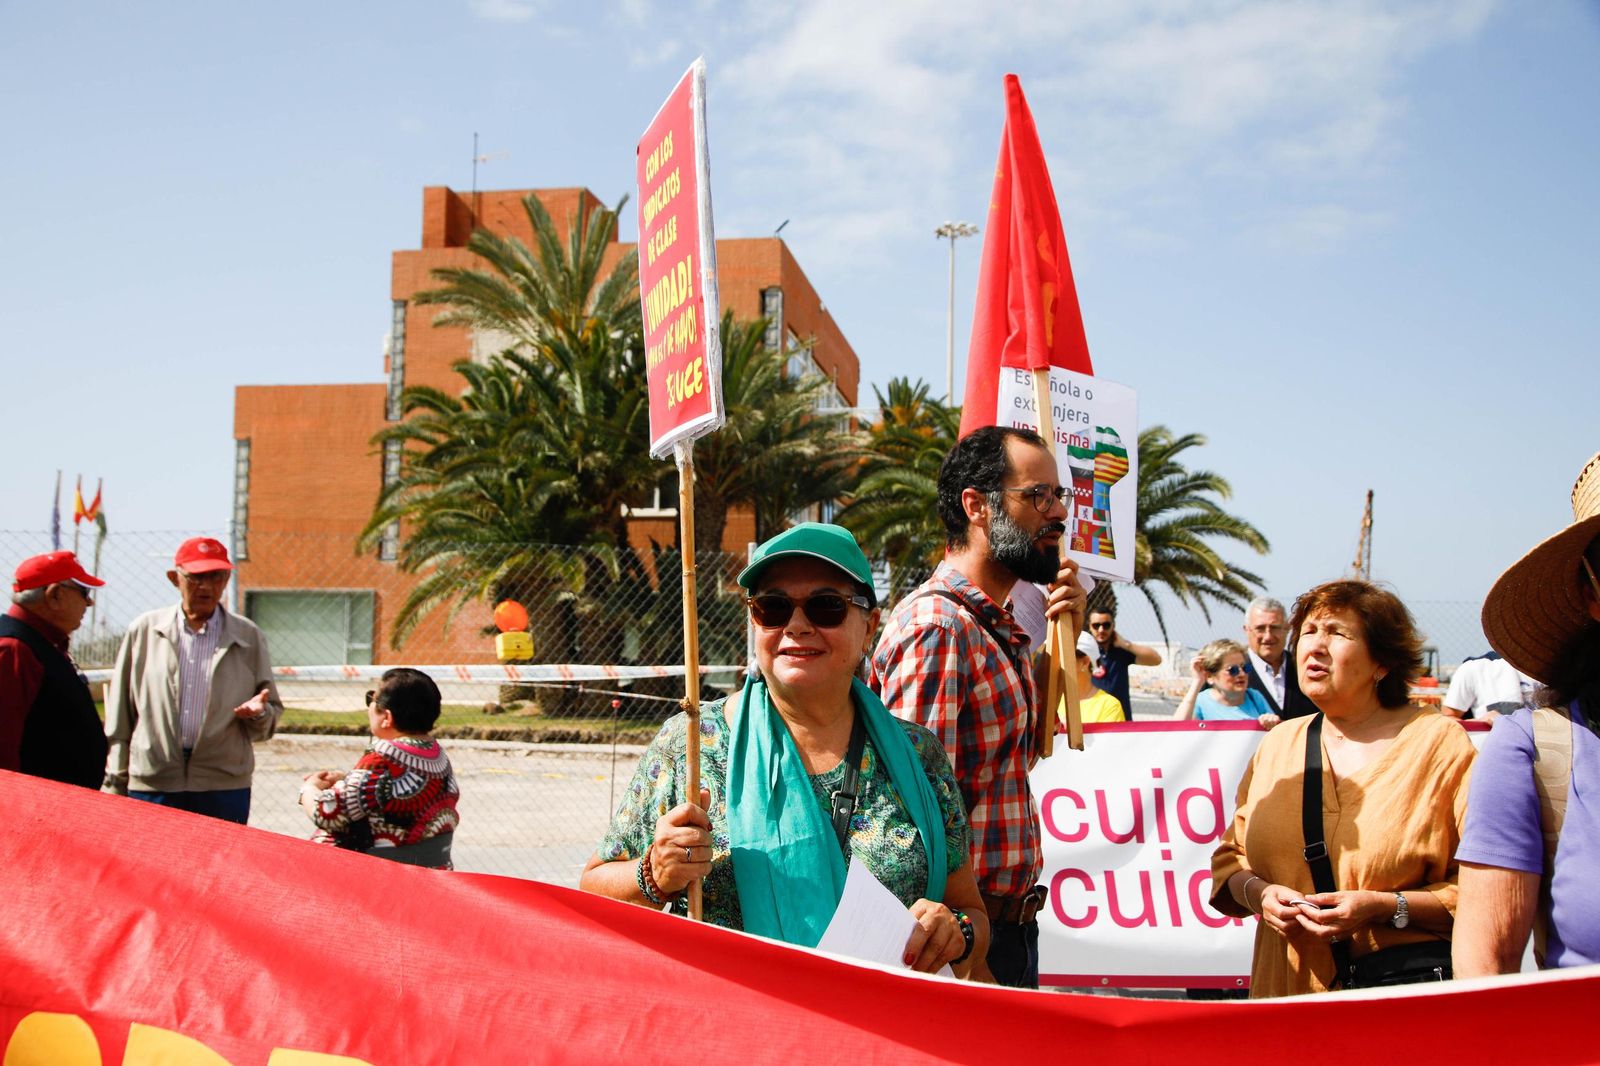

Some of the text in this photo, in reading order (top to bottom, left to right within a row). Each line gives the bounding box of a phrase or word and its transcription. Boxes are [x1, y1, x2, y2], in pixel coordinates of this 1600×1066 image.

[645, 129, 673, 185] CON LOS
[643, 166, 681, 232] SINDICATOS
[647, 215, 677, 267] DE CLASE
[675, 356, 703, 403] UCE
[1015, 370, 1093, 401] Esñola o
[1014, 396, 1090, 424] extnjera
[1053, 426, 1090, 448] isma
